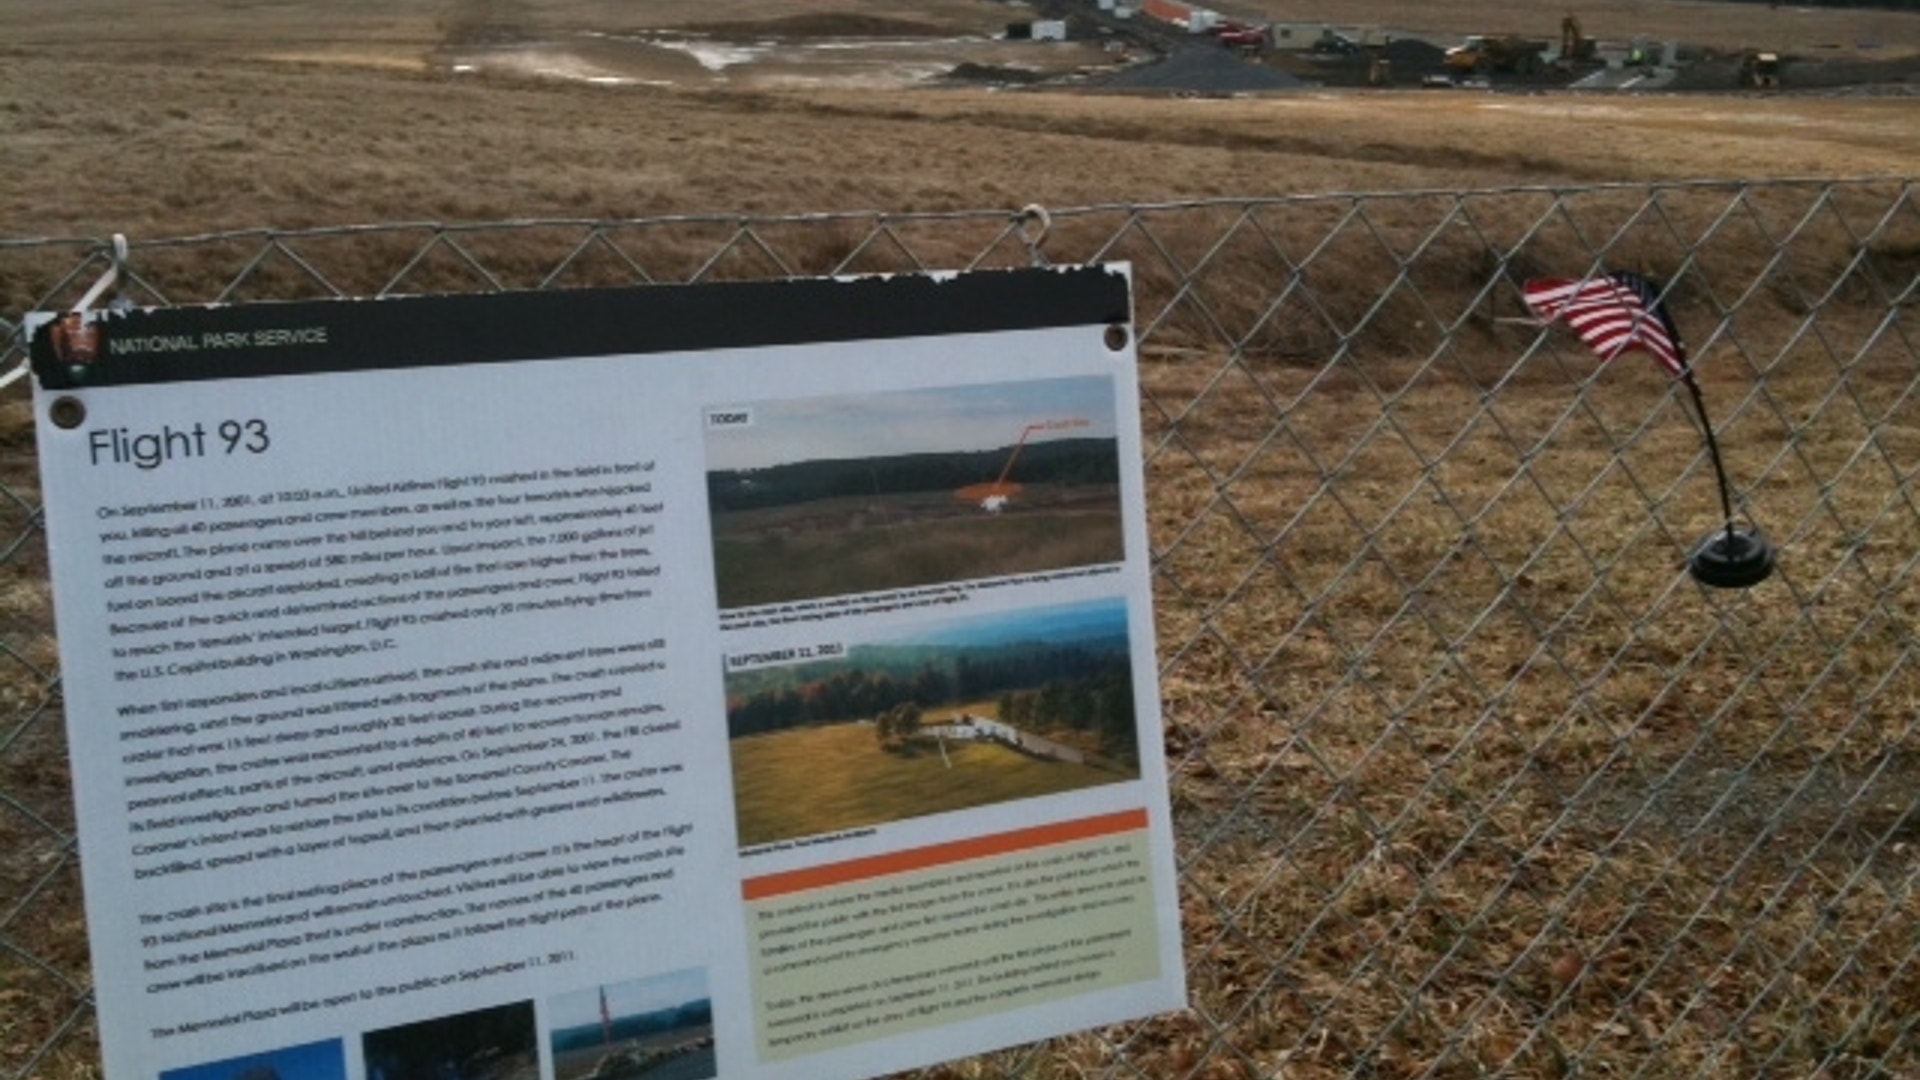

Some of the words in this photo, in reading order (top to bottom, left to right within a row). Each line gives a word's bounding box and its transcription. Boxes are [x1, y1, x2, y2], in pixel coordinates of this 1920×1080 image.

[110, 335, 198, 355] NATIONAL
[203, 332, 250, 348] PARK
[254, 327, 328, 346] SERVICE
[89, 422, 206, 469] Flight
[218, 419, 271, 455] 93
